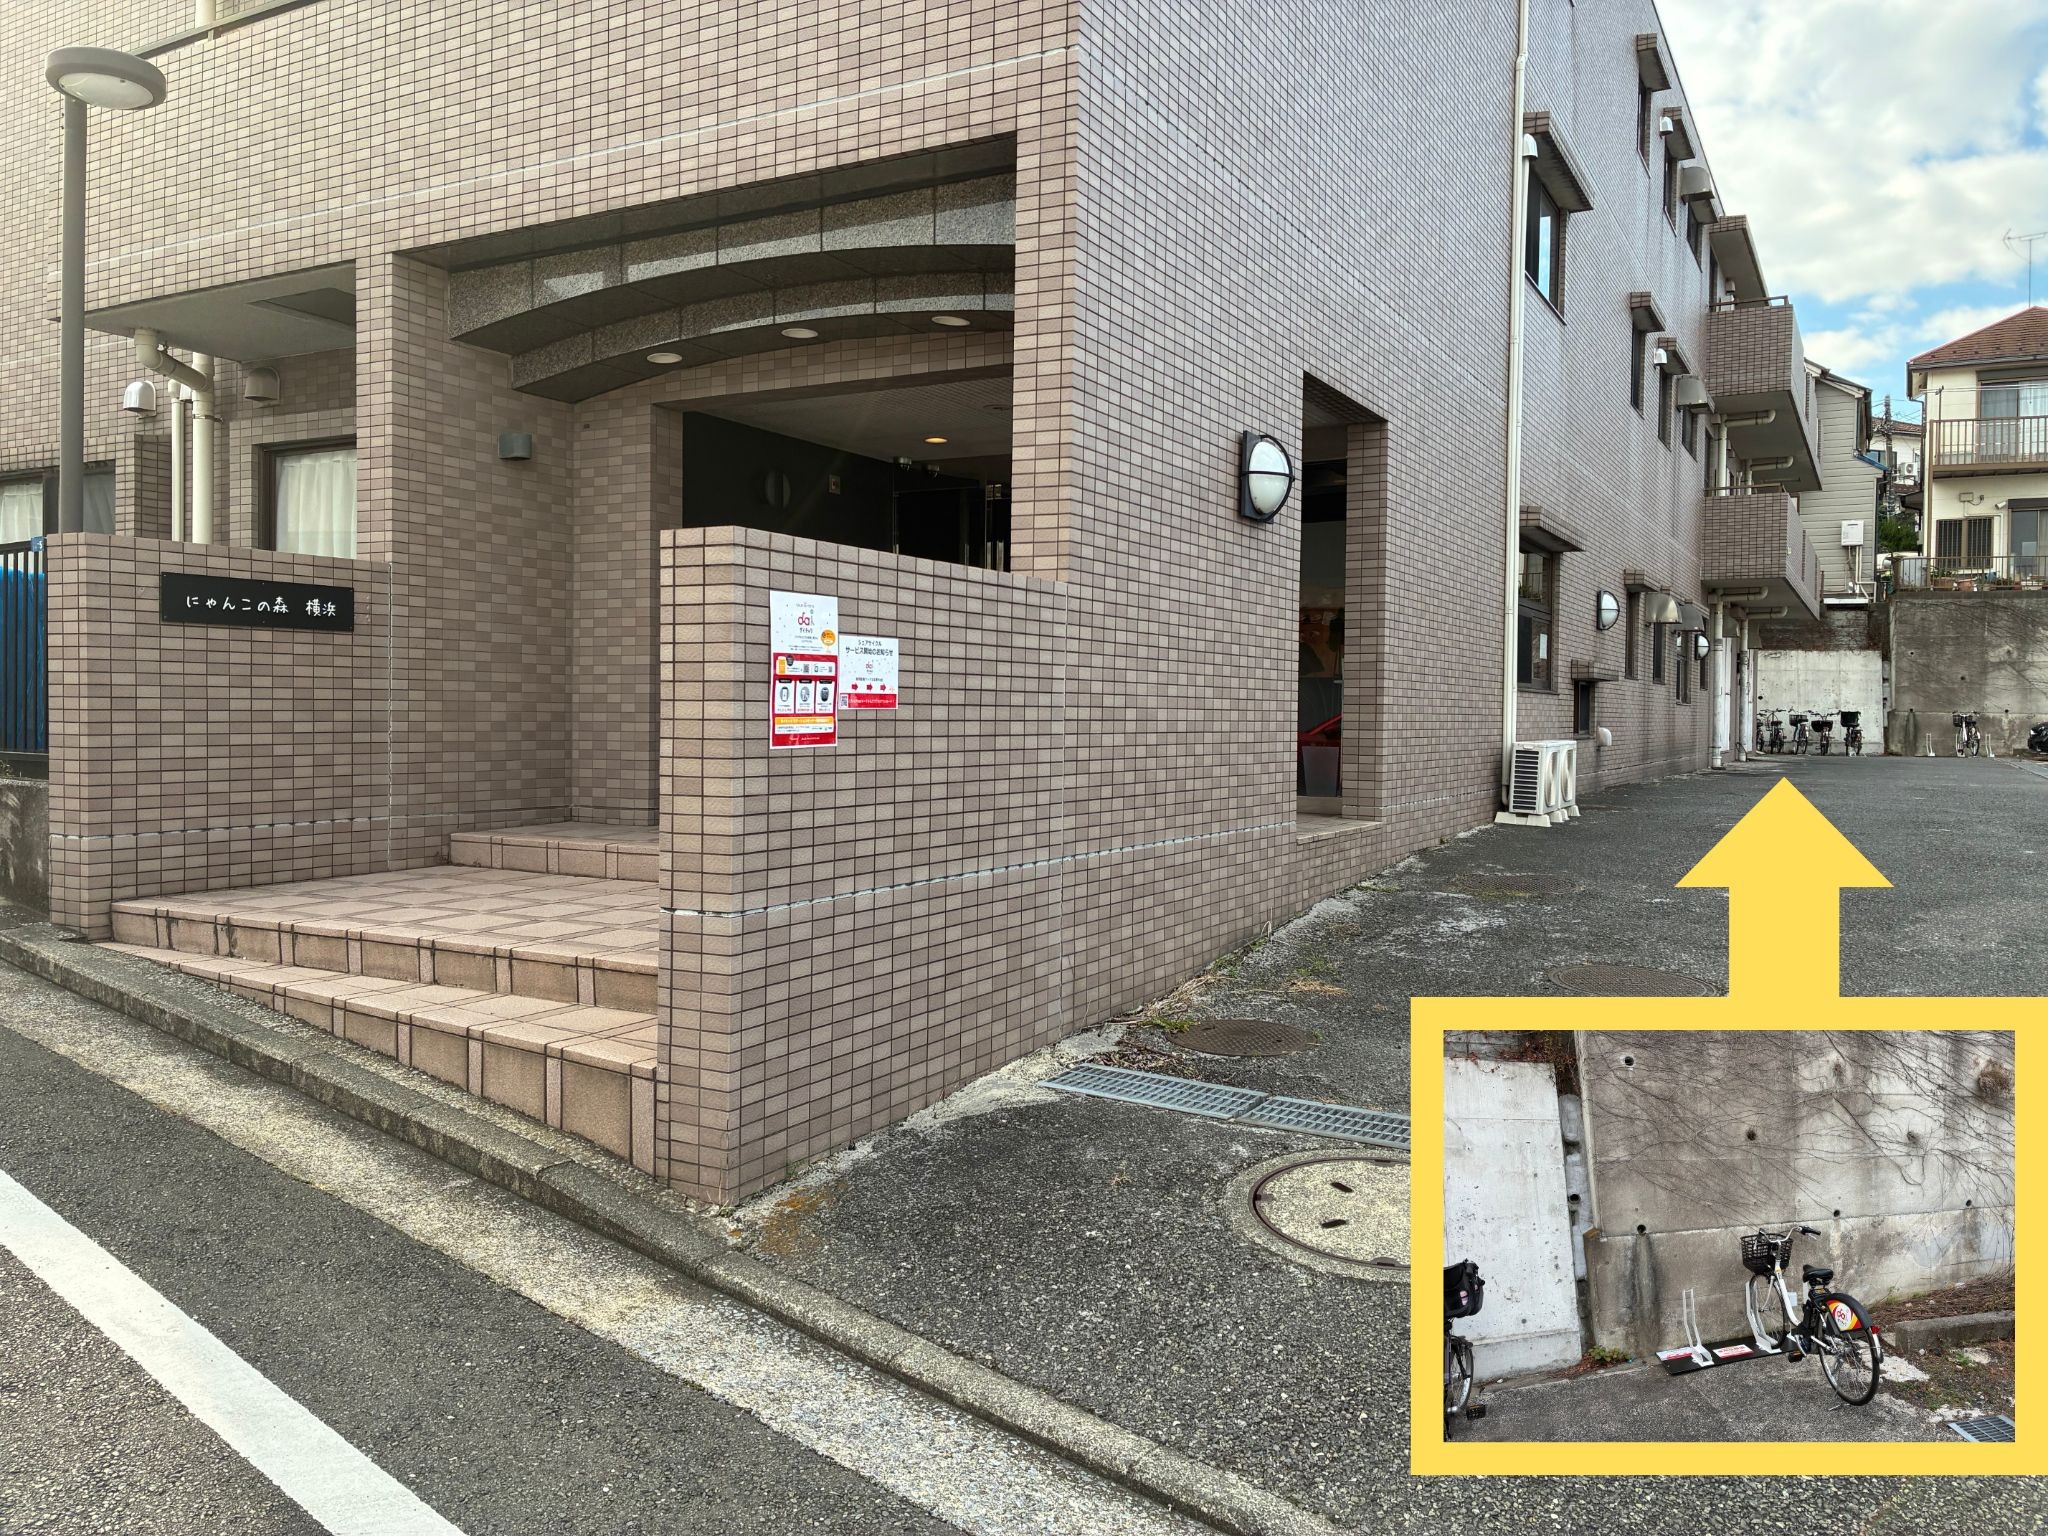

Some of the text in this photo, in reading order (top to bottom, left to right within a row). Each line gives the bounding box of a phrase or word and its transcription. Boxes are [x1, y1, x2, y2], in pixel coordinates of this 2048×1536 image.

[185, 595, 337, 617] にゃんこの森 横浜
[845, 646, 894, 657] サービス開始のお知らせ
